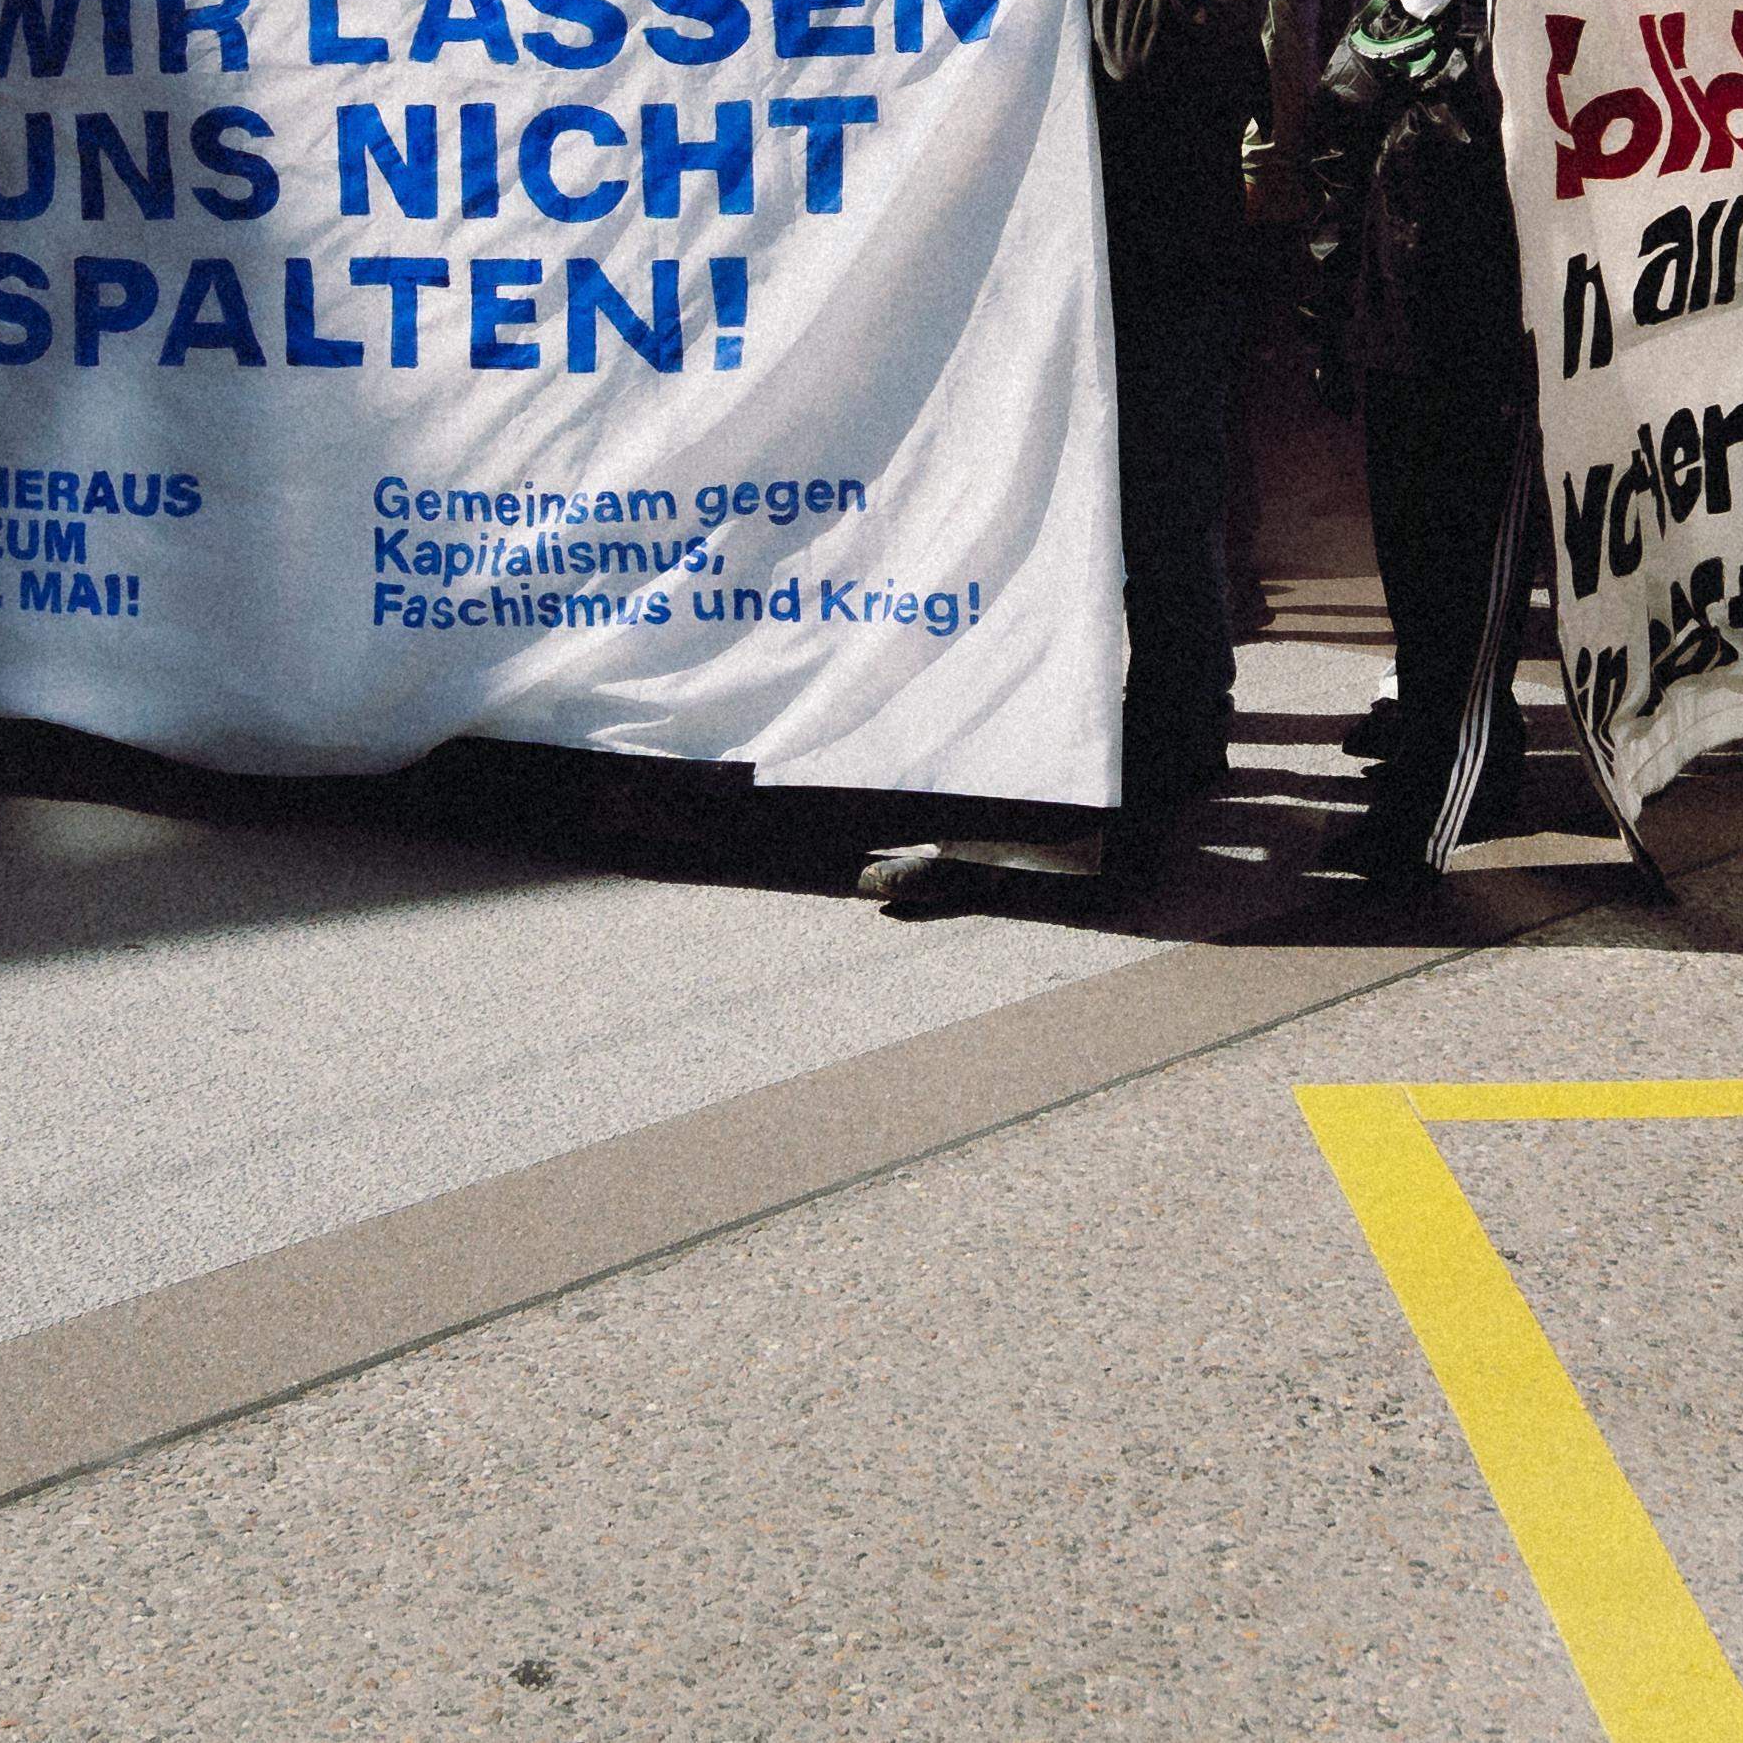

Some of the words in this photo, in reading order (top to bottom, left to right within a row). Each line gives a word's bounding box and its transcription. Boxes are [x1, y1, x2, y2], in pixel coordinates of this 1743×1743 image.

[337, 94, 879, 224] NICHT
[373, 475, 678, 528] Gemeinsam
[695, 477, 867, 528] gegen
[373, 527, 725, 587] Kapitalismus,
[19, 570, 141, 618] MAI!
[373, 582, 672, 630] Faschismus
[692, 577, 801, 624] und
[819, 578, 981, 638] Krieg!
